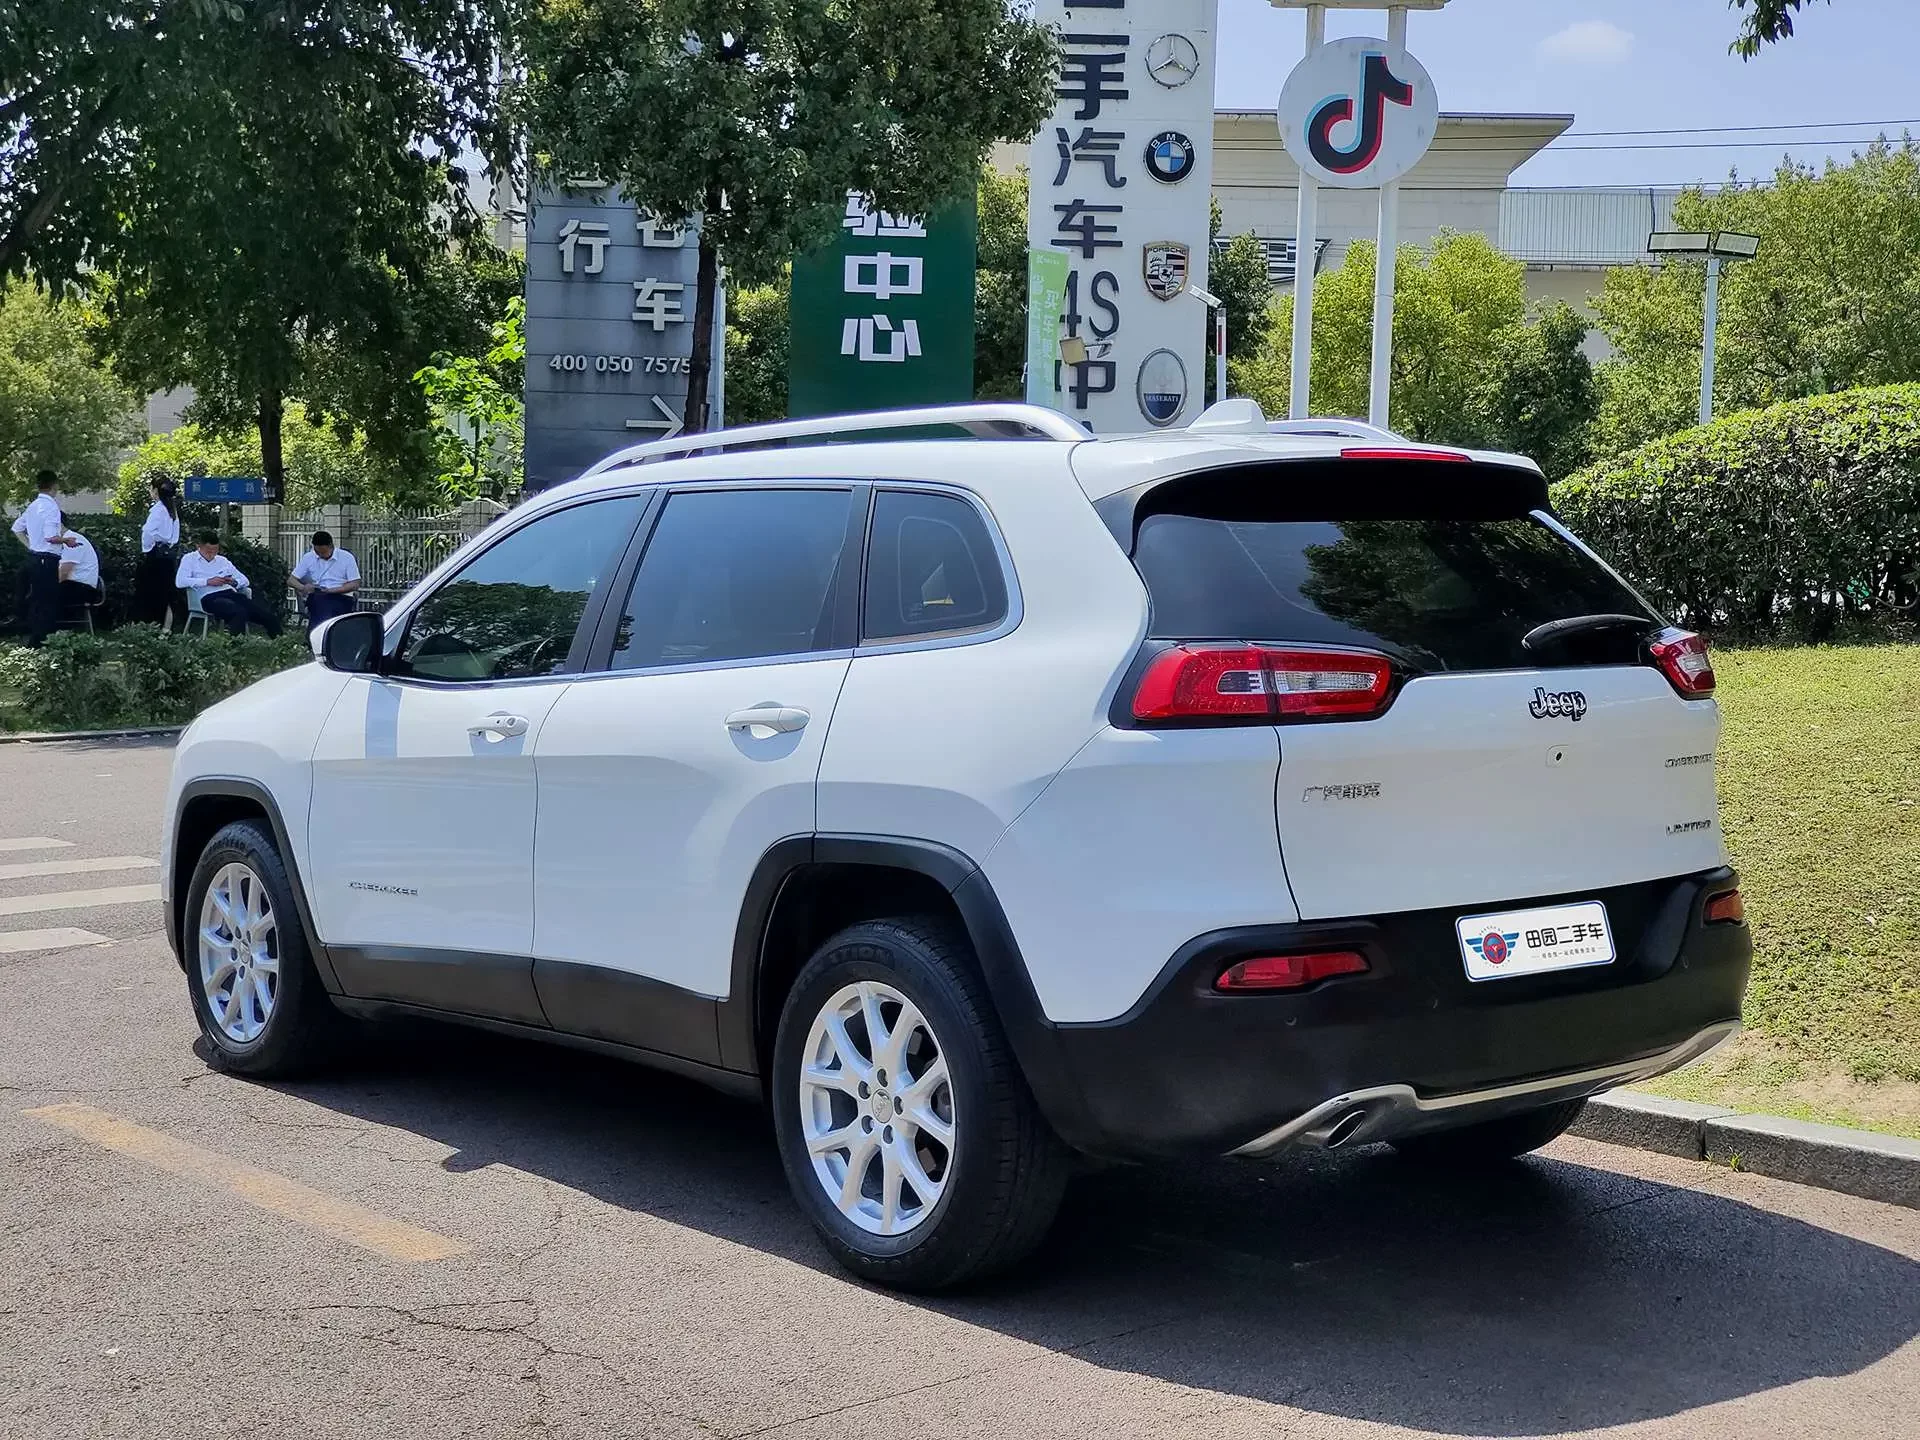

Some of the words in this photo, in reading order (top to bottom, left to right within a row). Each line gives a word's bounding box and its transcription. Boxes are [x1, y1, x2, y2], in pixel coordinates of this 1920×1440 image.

[1150, 133, 1191, 150] BMW
[1147, 246, 1187, 255] PORSCHE
[549, 355, 588, 371] 400
[595, 356, 634, 372] 050
[643, 357, 691, 374] 7575
[1529, 687, 1588, 721] Jeep
[1525, 923, 1604, 949] 田园二手车
